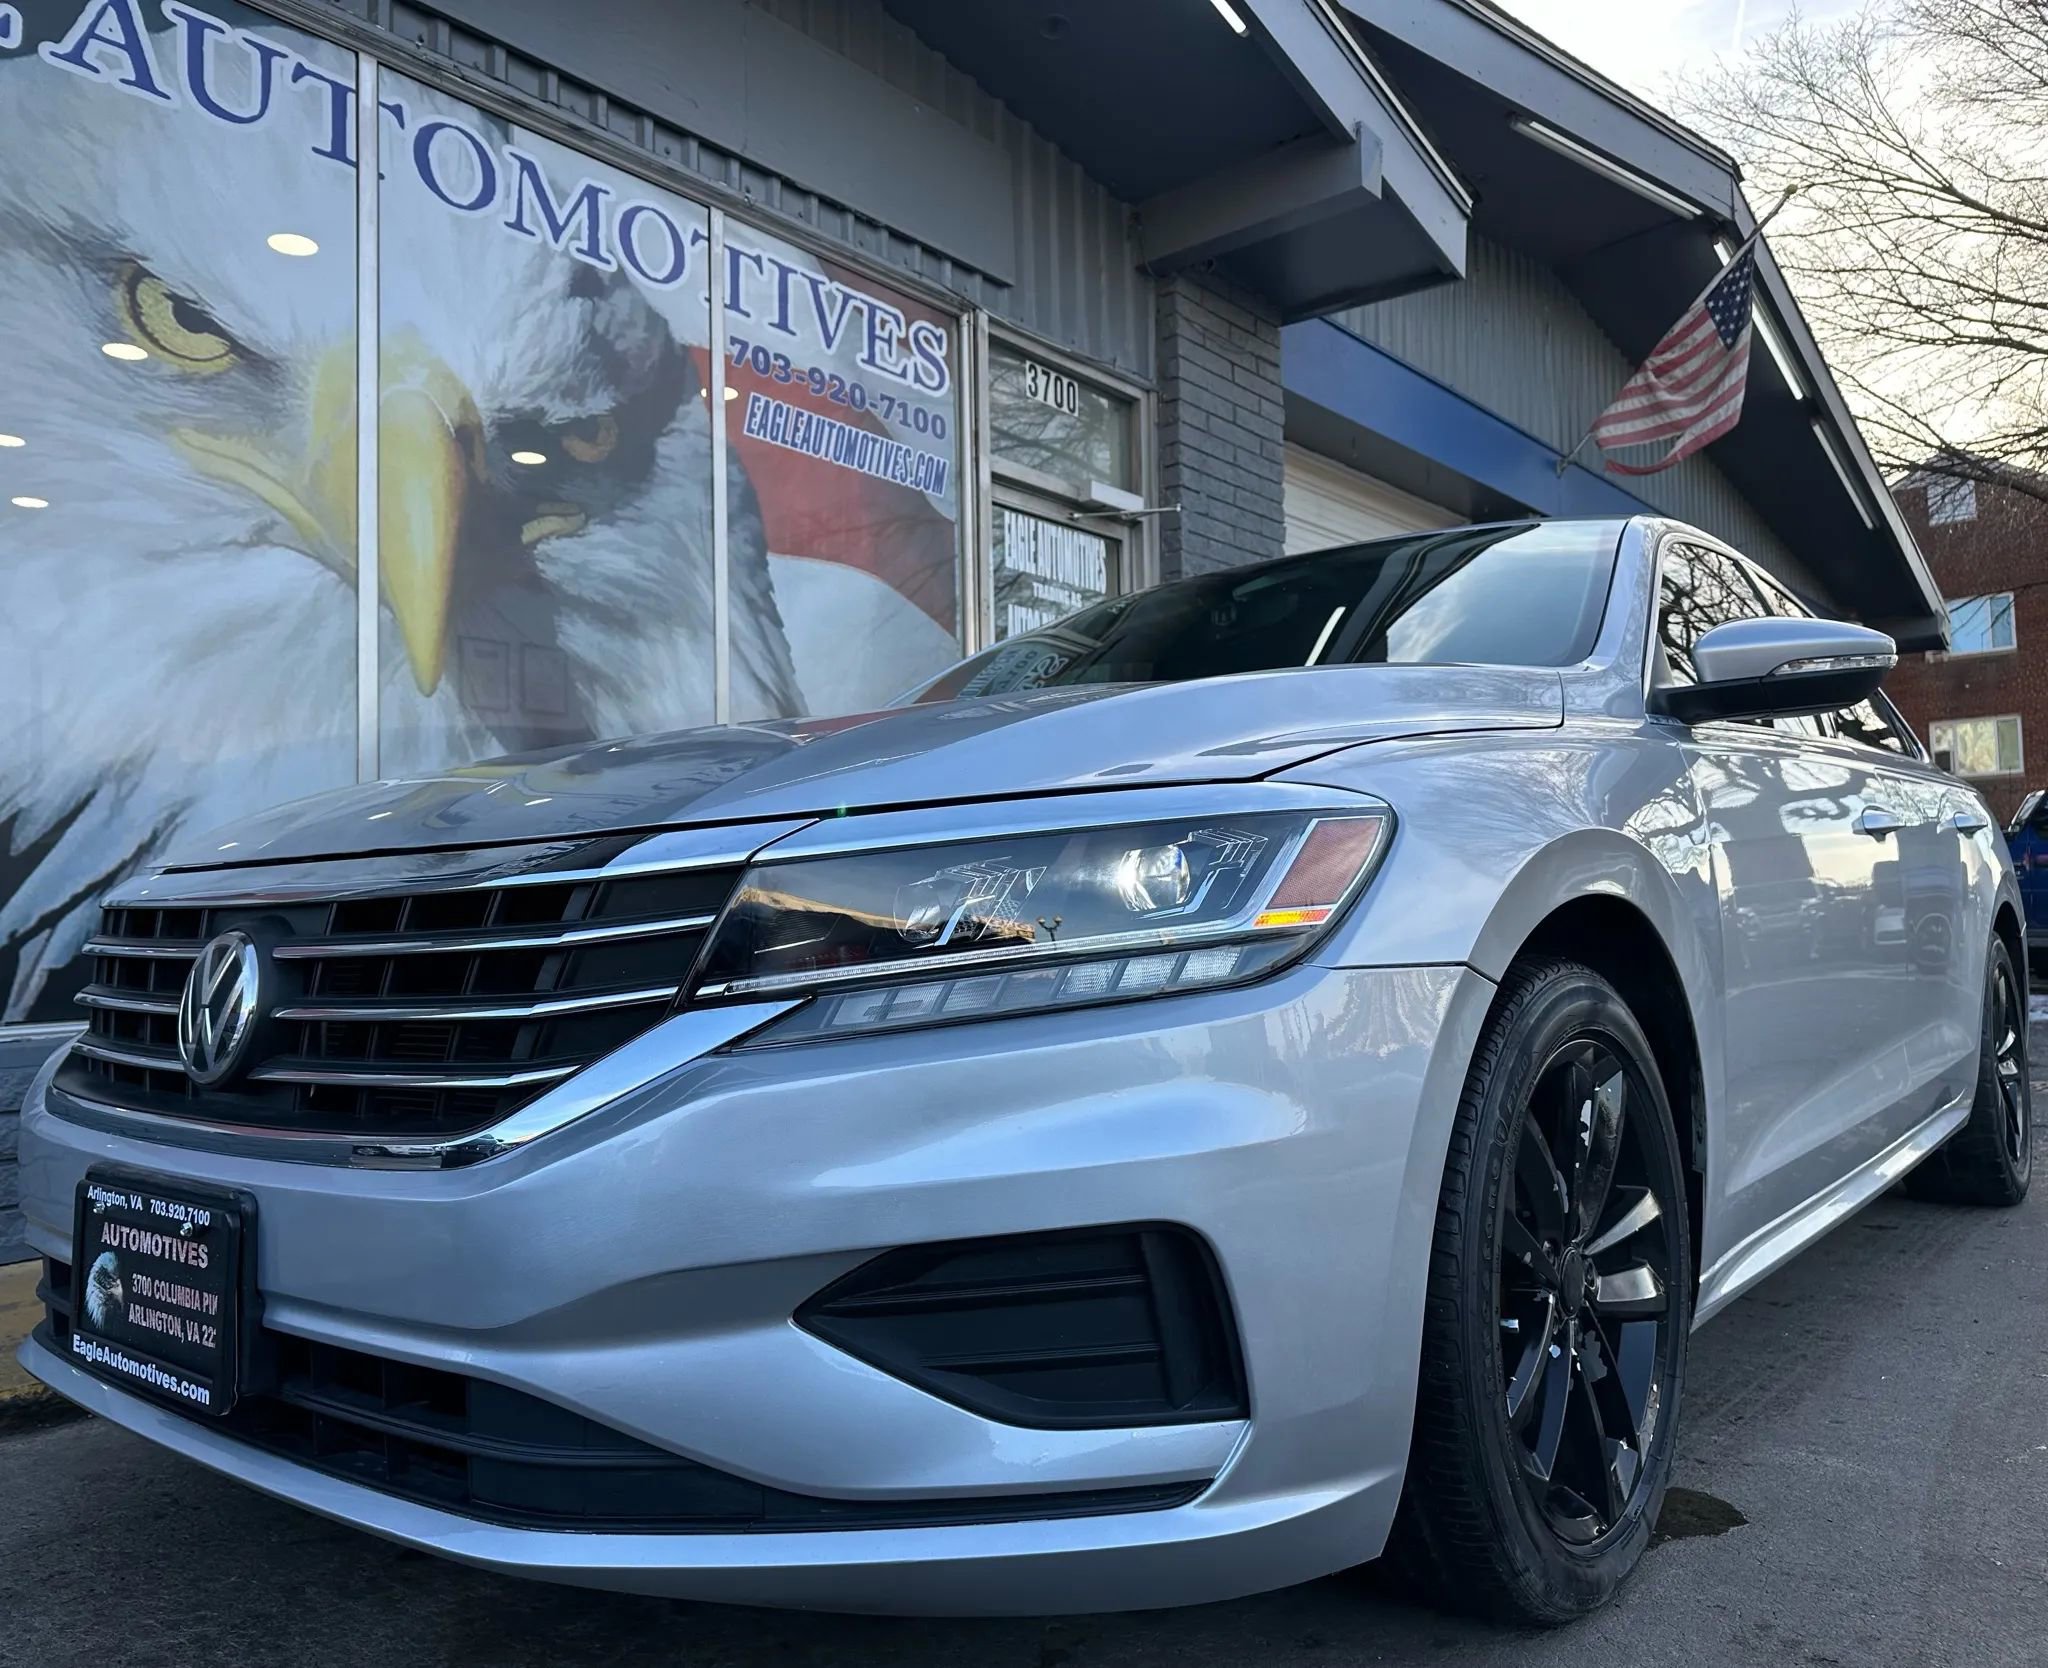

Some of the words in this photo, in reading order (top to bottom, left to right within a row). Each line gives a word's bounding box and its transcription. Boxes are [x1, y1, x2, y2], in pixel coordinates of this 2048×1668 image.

[49, 0, 949, 392] AUTOMOTIVES
[730, 336, 946, 440] 703-920-7100
[1027, 367, 1077, 413] 3700
[747, 396, 948, 495] EAGLEAUTOMOTIVES.COM
[1004, 510, 1036, 575] EAGLE
[1037, 520, 1106, 595] AUTOMOTIVES
[88, 1185, 128, 1210] Arlington,
[130, 1194, 143, 1211] VA
[150, 1199, 210, 1226] 703.920.7100
[101, 1222, 209, 1269] AUTOMOTIVES
[131, 1273, 152, 1297] 3700
[154, 1279, 201, 1312] COLUMBIA
[128, 1303, 185, 1344] ARLINGTON,
[186, 1319, 200, 1344] VA
[72, 1333, 211, 1405] EagleAutomotives.com
